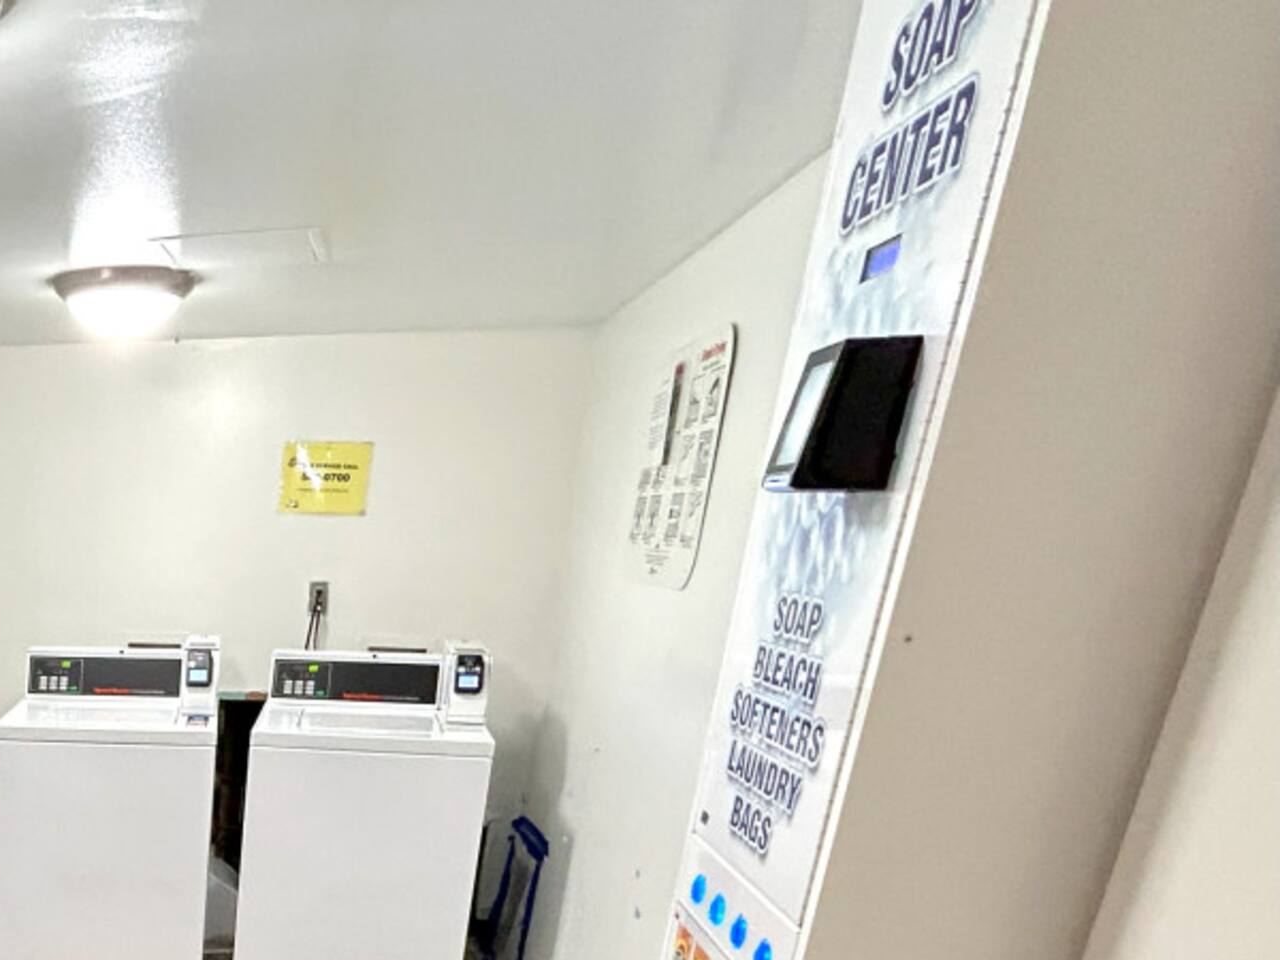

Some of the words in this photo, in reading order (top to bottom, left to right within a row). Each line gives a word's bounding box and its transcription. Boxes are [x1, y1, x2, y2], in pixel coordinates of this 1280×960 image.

[882, 0, 976, 106] SOAP
[840, 80, 976, 231] CENTER
[773, 596, 822, 639] SOAP
[752, 645, 822, 700] BLEACH
[730, 689, 825, 763] SOFTENERS
[726, 740, 802, 811] LAUNDRY
[729, 795, 772, 851] BAGS
